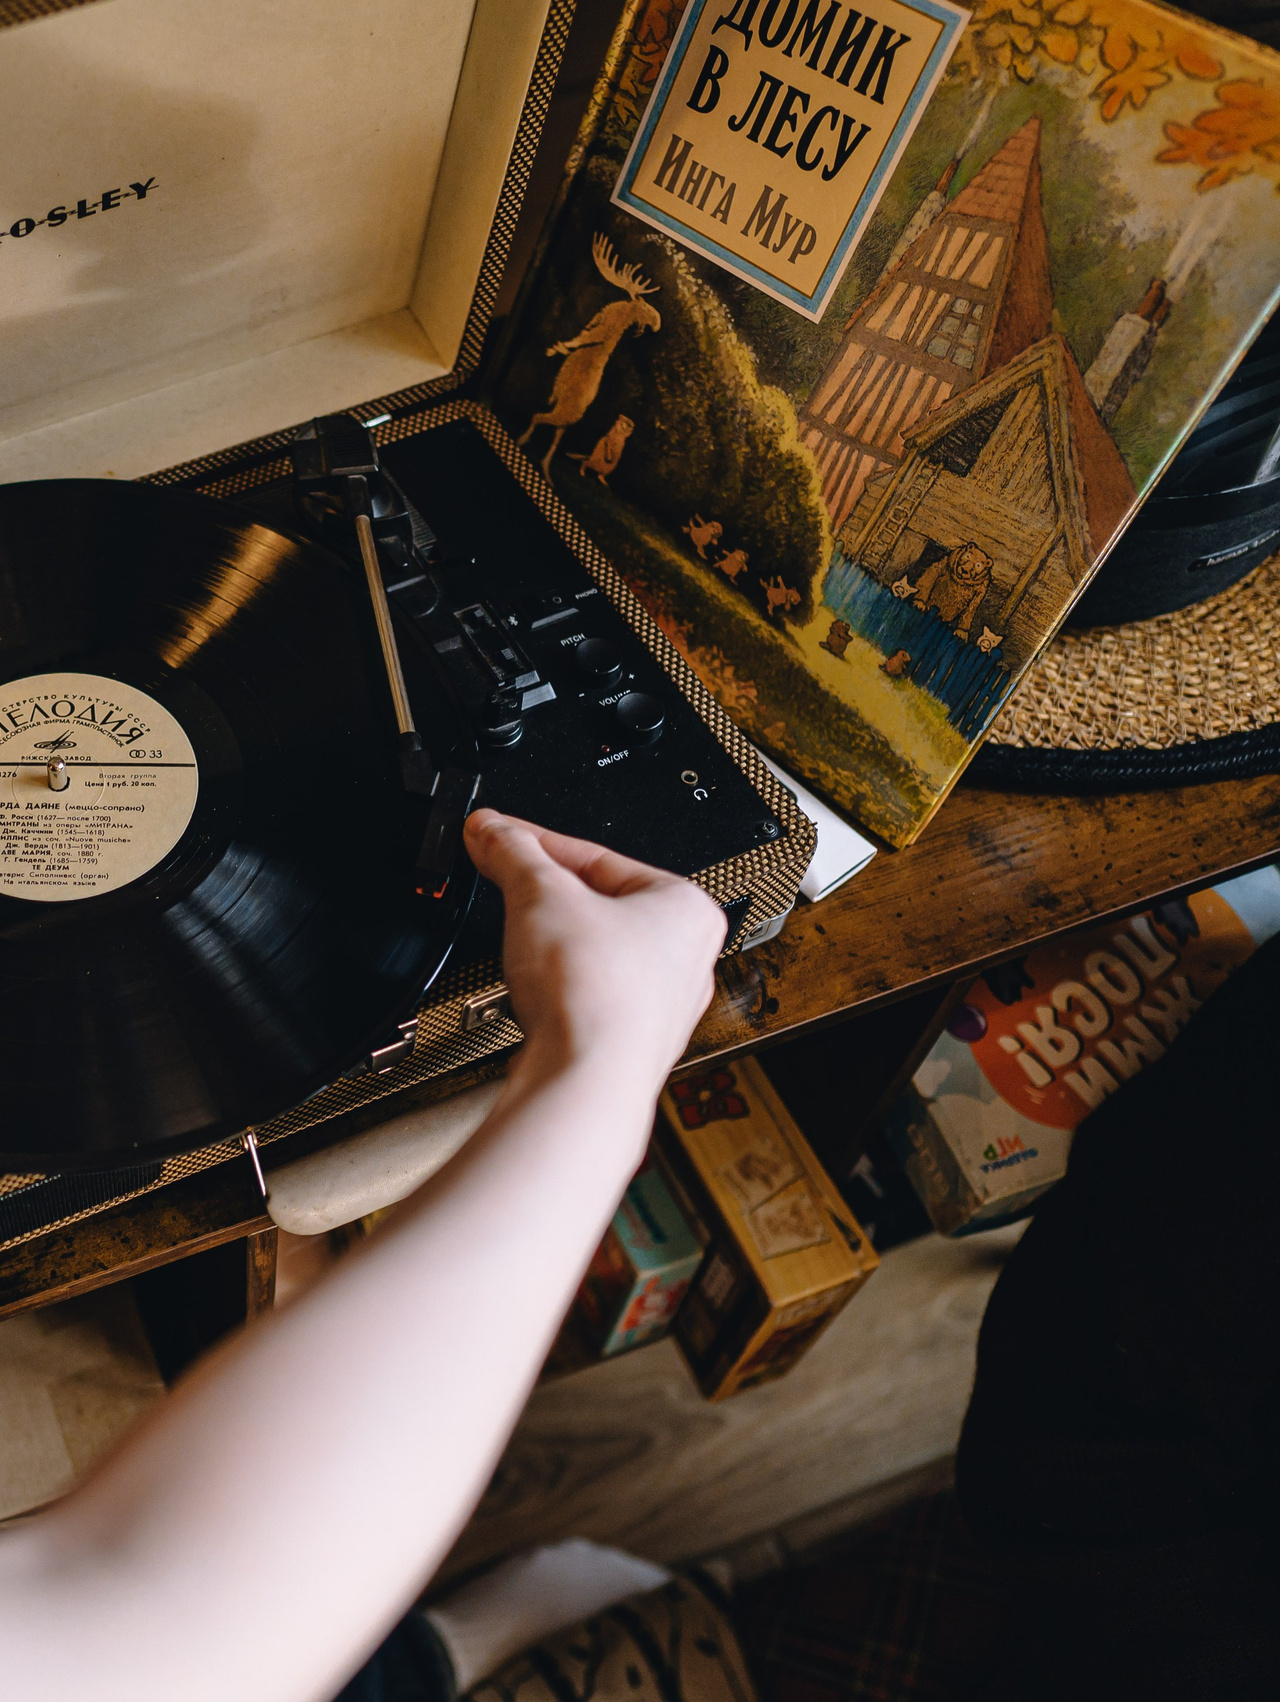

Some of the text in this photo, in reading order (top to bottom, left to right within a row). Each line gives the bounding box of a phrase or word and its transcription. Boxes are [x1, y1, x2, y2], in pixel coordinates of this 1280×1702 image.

[711, 0, 912, 105] ДОМИК
[686, 44, 872, 182] В ЛЕСУ
[575, 588, 598, 600] PHONO
[560, 632, 586, 647] PITCH
[599, 690, 631, 707] VOL
[64, 694, 123, 713] КУЛЬТУРЫ
[127, 713, 151, 733] СССР
[43, 718, 71, 726] ФИРМА
[72, 719, 126, 748] ГРАМПЛАСТИНОК
[149, 749, 163, 759] 33
[597, 749, 631, 768] ON/OFF
[25, 802, 61, 811] ДАЙНЕ
[65, 803, 145, 813] (меццо-сопрано)
[80, 872, 109, 880] (орган)
[982, 1136, 1026, 1162] ИГР
